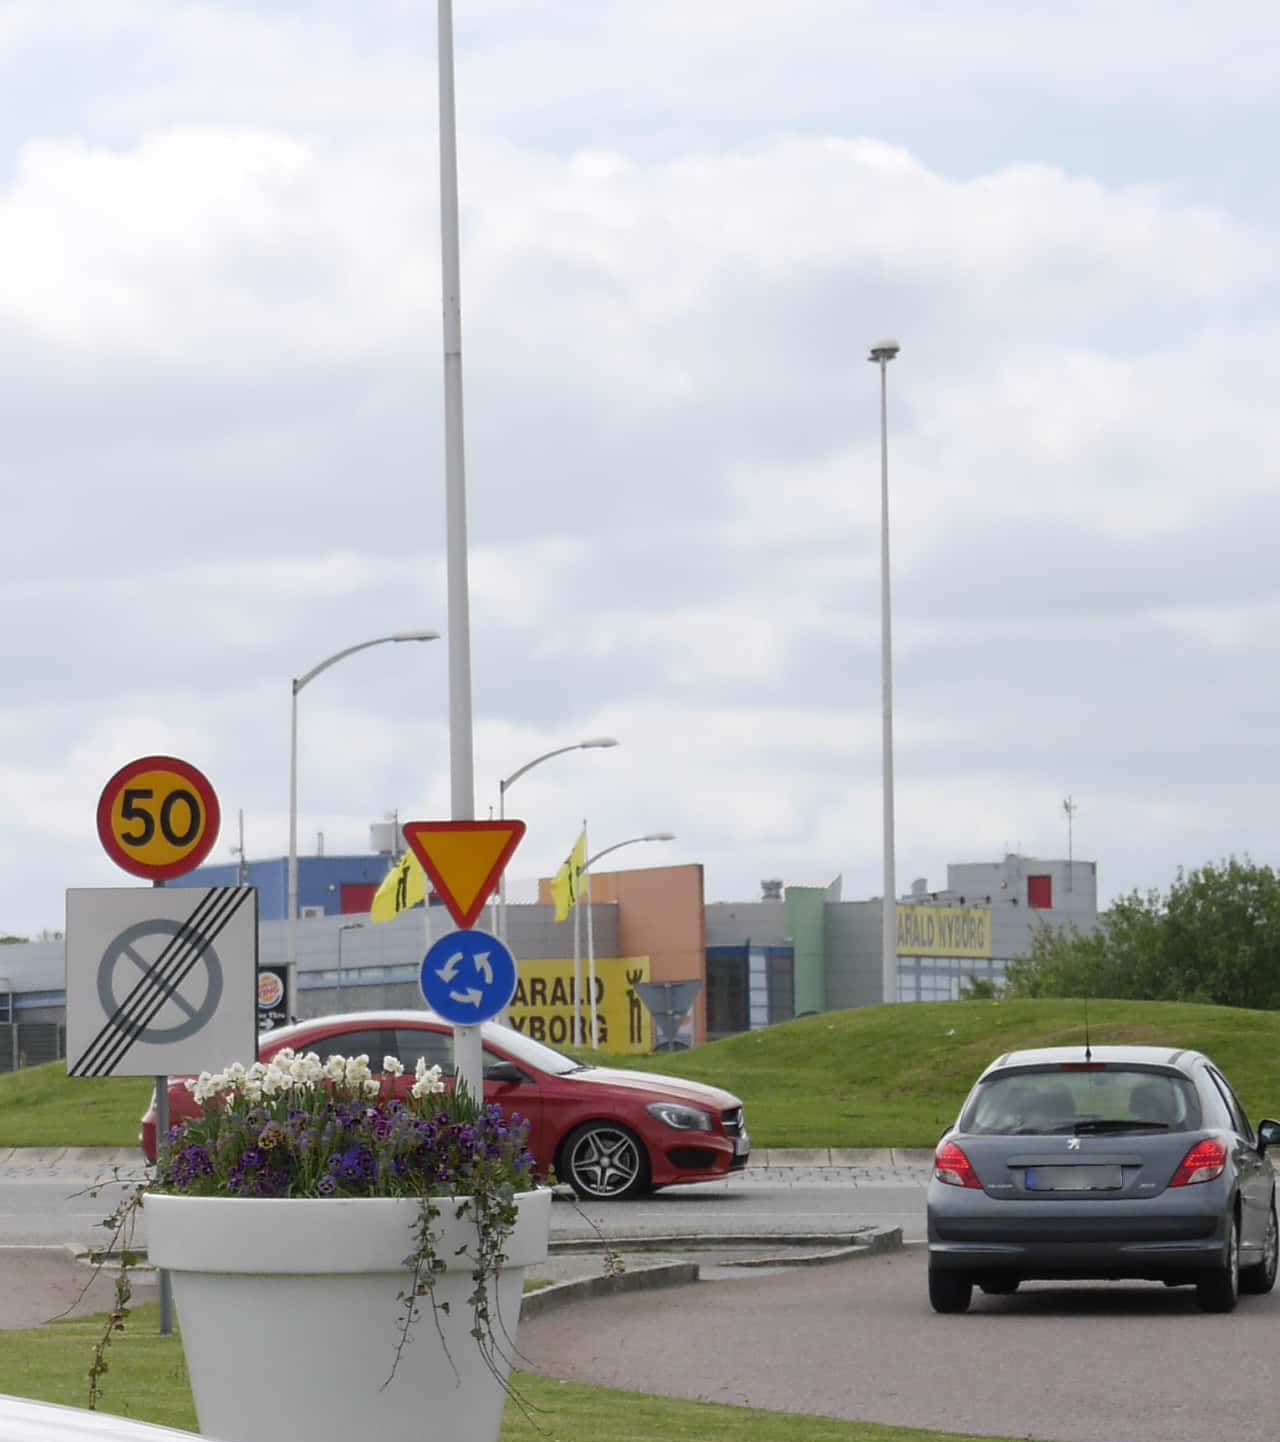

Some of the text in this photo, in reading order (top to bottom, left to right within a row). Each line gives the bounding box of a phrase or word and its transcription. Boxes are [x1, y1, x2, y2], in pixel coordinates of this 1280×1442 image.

[121, 788, 200, 847] 50
[896, 912, 935, 948] ARALD
[511, 976, 604, 1006] ARALD
[509, 1014, 608, 1044] YBORG
